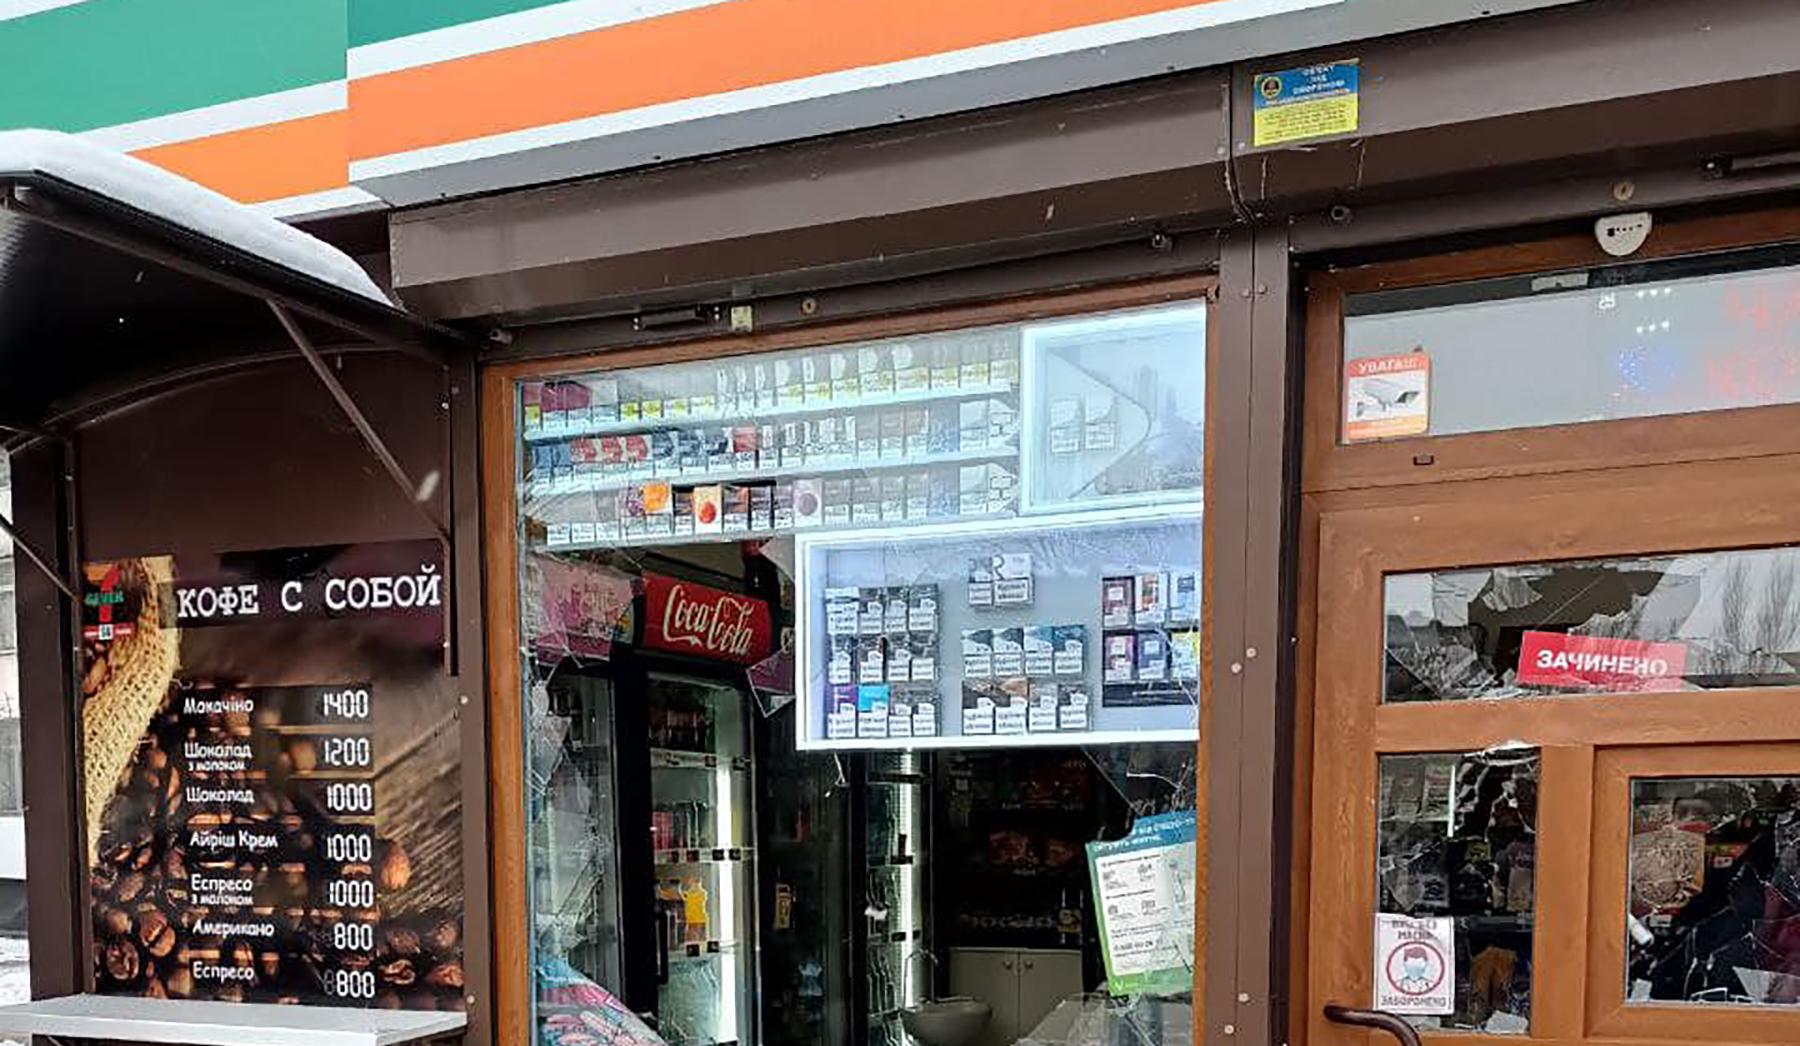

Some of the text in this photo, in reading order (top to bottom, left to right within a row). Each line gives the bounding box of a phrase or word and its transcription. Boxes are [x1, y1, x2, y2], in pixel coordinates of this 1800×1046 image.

[177, 564, 442, 618] КОФЕ С СОБОЙ
[662, 583, 755, 656] Coca-Cola
[1536, 649, 1669, 676] ЗАЧИНЕНО
[183, 690, 369, 718] Мокачіно 1400
[184, 738, 370, 766] Шоколад 1200
[196, 760, 246, 772] молоком
[186, 783, 372, 811] Шоколад 1000
[189, 830, 372, 862] Айріш Крем 1000
[191, 873, 374, 907] Еспресо 1000
[200, 894, 254, 906] молоком
[192, 918, 374, 951] Американо 800
[192, 960, 255, 983] Еспресо
